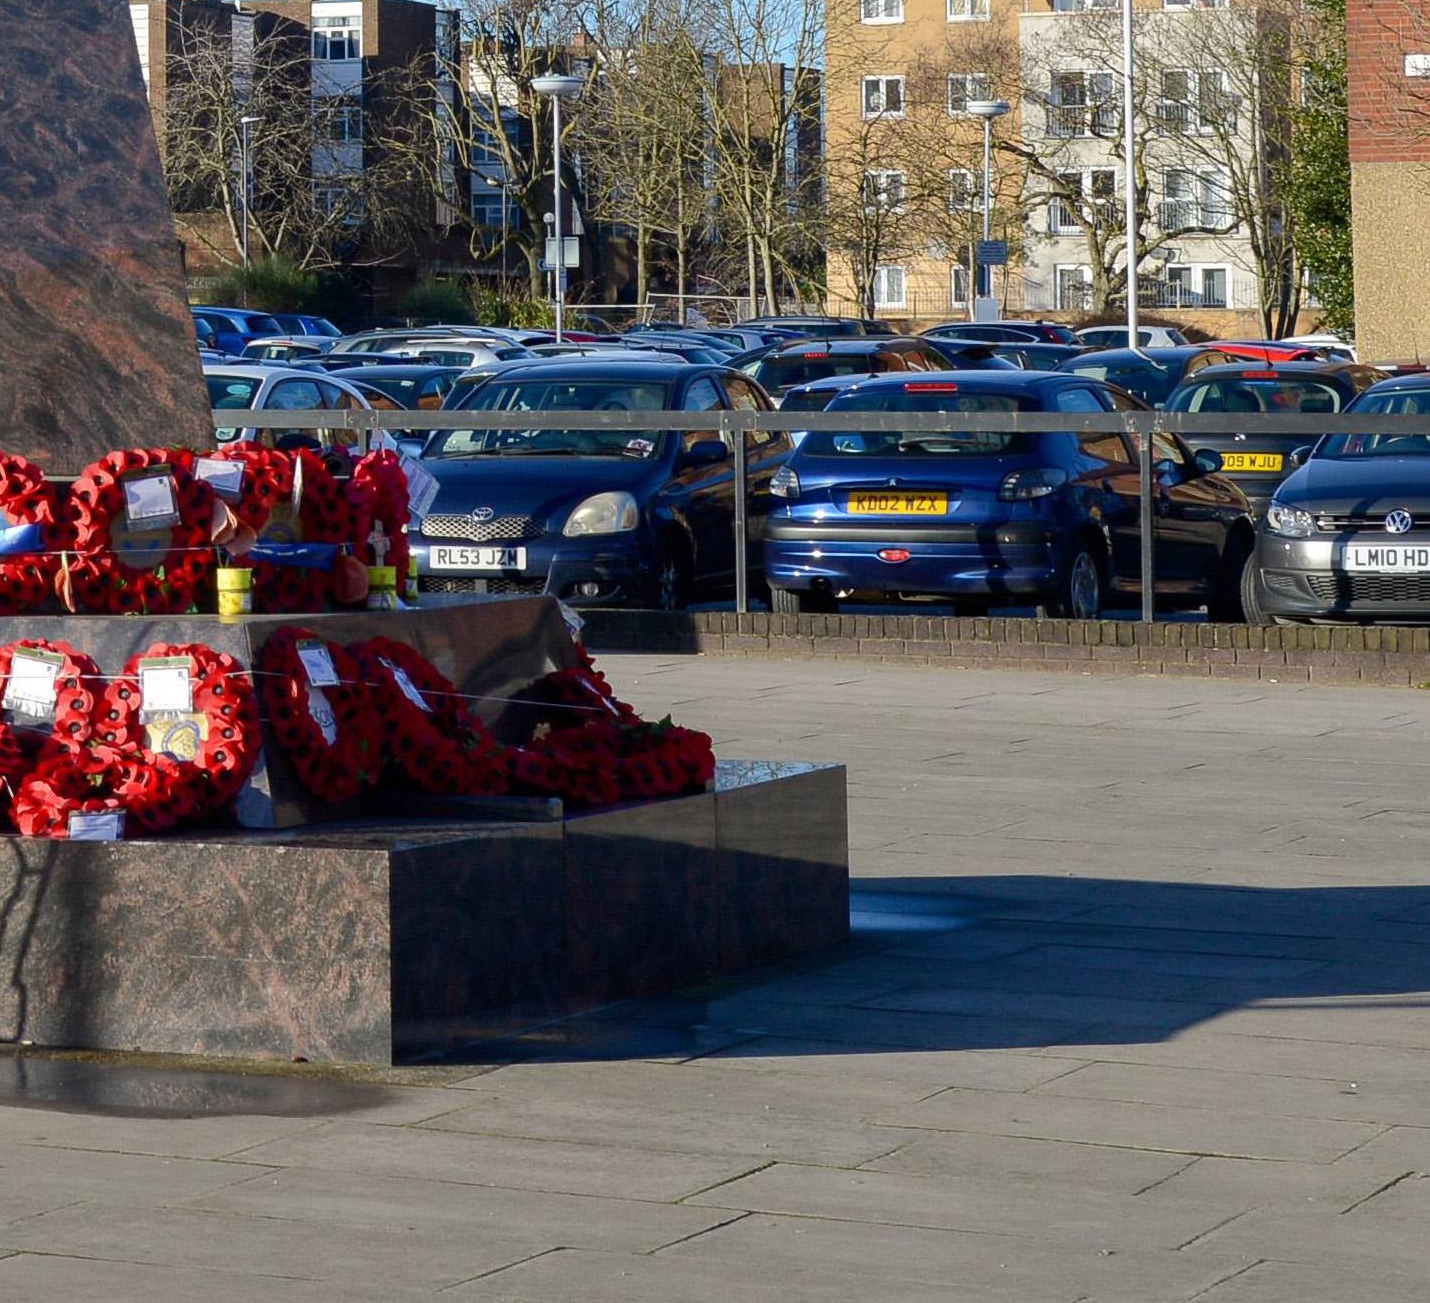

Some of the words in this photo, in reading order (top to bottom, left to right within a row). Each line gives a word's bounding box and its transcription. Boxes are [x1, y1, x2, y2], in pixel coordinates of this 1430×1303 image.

[1223, 456, 1245, 468] 09
[1249, 456, 1276, 468] WJU
[856, 495, 899, 511] KD02
[437, 548, 481, 565] RL53
[485, 548, 518, 566] JZM
[1355, 549, 1398, 566] LM10
